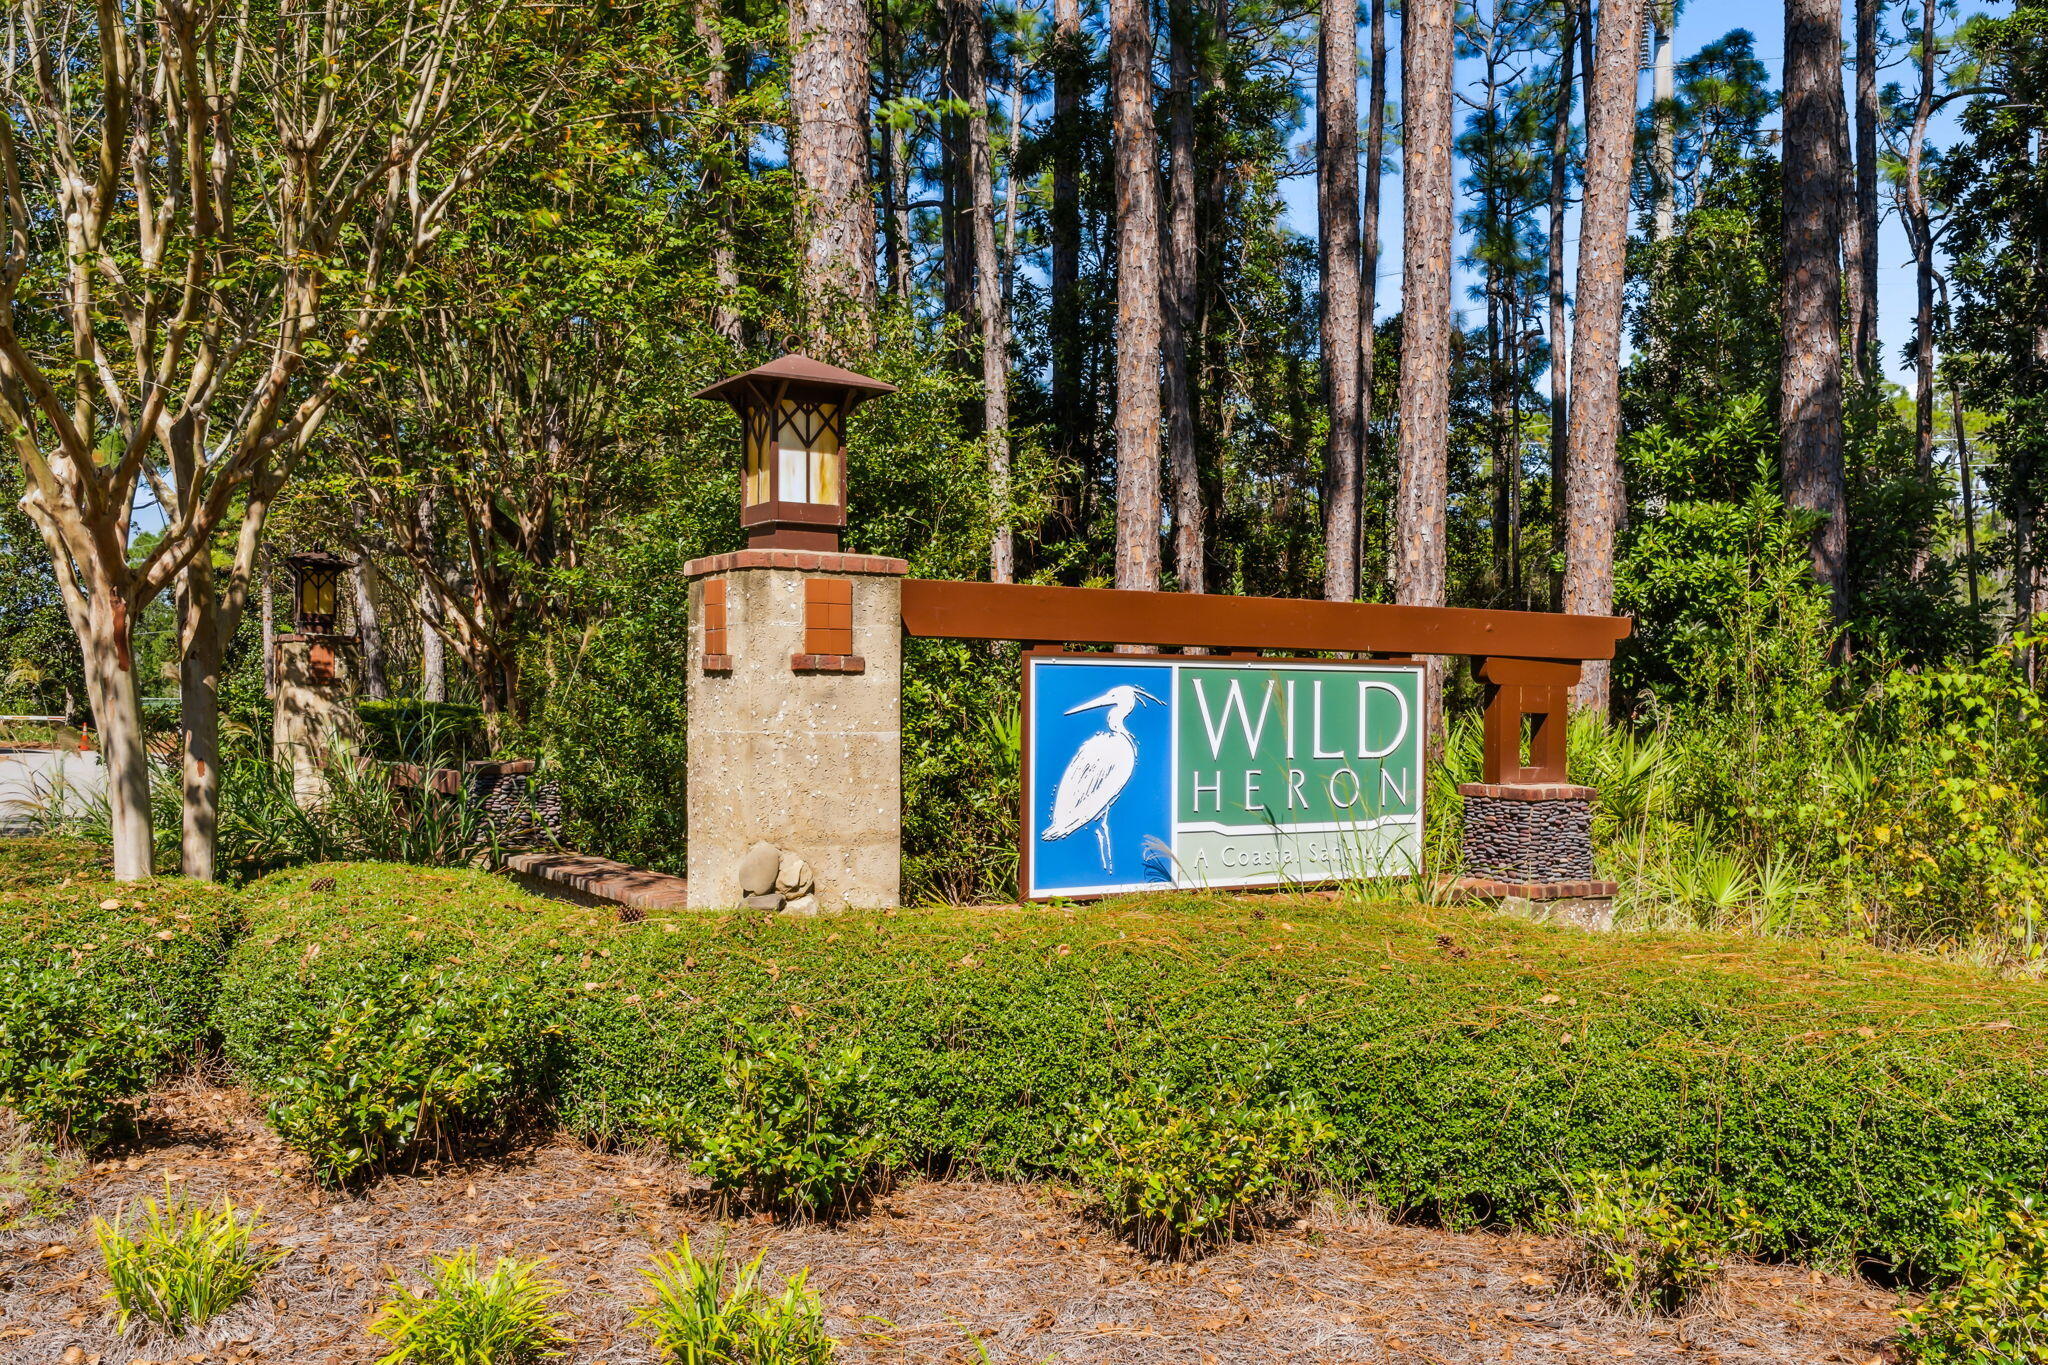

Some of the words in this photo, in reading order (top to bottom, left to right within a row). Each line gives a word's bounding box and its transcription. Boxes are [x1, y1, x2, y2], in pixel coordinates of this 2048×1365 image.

[1192, 678, 1409, 762] WILD
[1193, 766, 1407, 813] HERON
[1193, 847, 1209, 869] A
